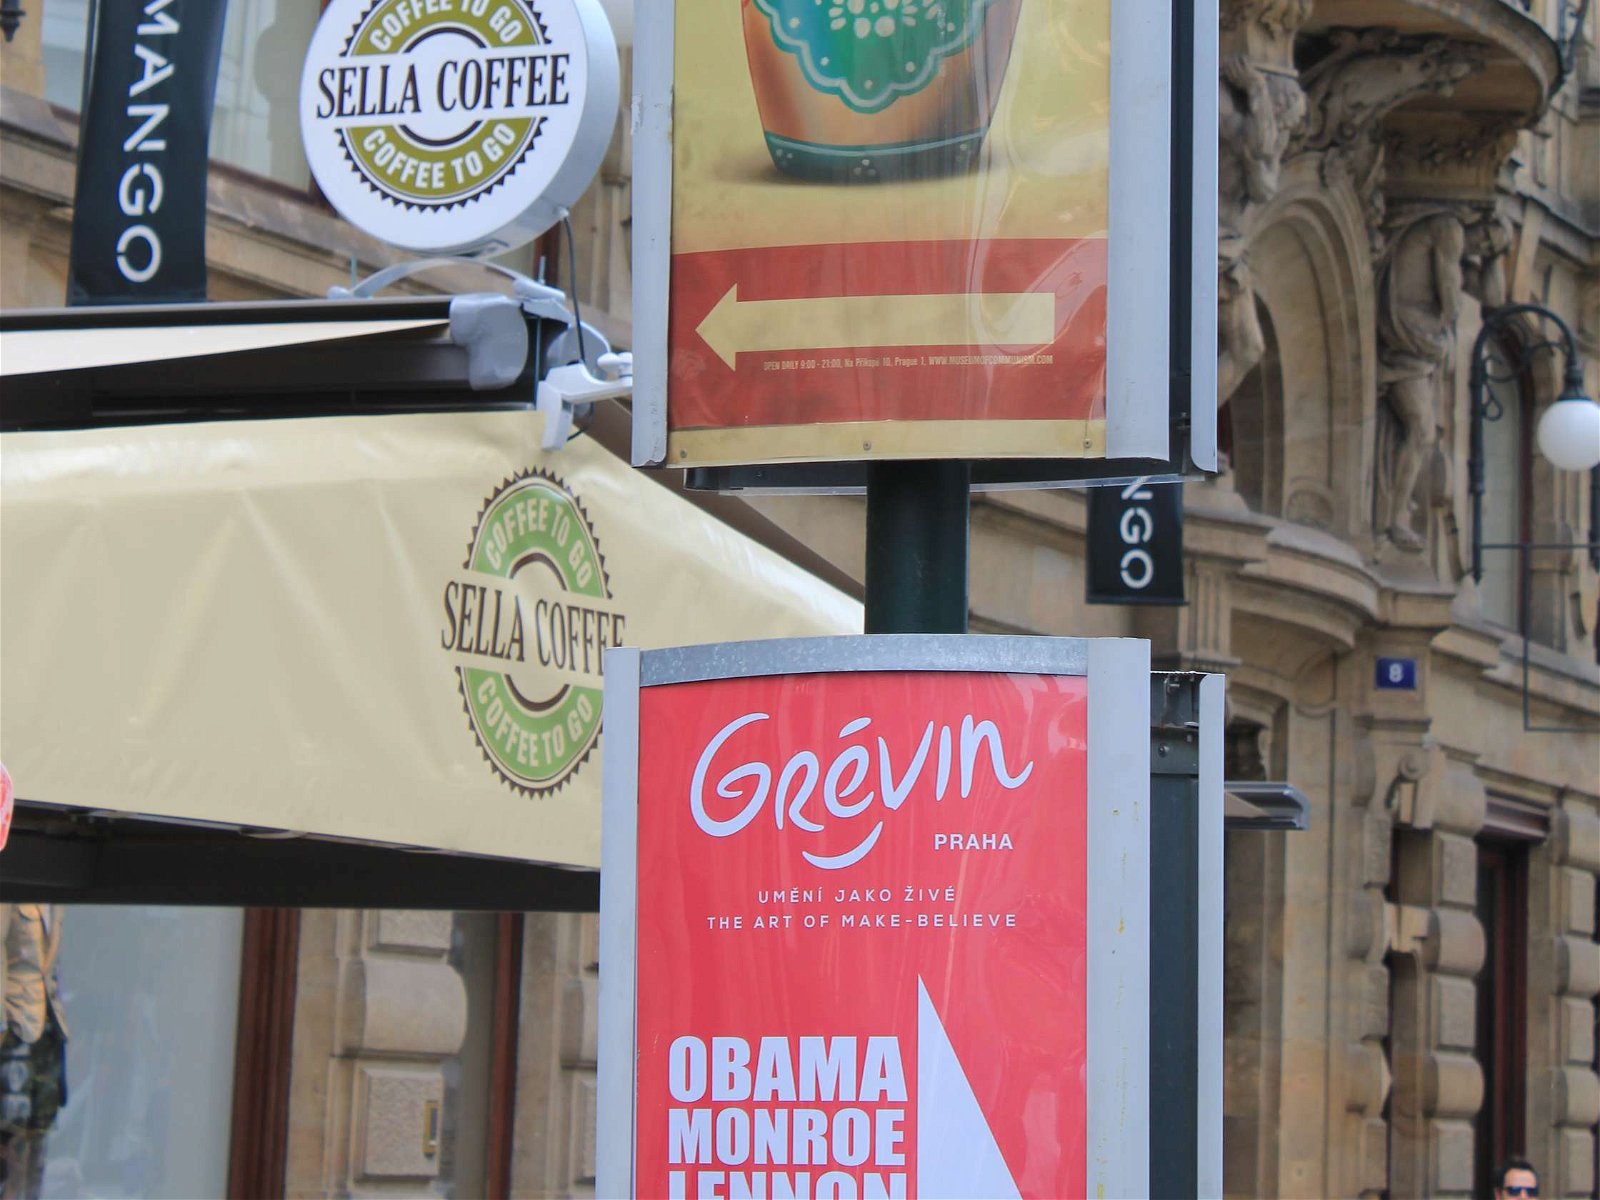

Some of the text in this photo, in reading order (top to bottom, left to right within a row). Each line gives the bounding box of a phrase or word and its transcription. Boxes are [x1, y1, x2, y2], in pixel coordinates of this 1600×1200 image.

[489, 5, 523, 43] GO
[316, 54, 570, 119] SELLA COFFEE
[363, 123, 516, 189] COFFEE TO GO
[894, 356, 918, 368] Prague
[485, 498, 592, 588] COFFEE TO GO
[1121, 476, 1154, 590] NGO
[441, 580, 525, 663] SELLA
[477, 676, 593, 767] COFFEE TO GO
[934, 833, 1013, 850] PRAHA
[707, 913, 1017, 929] THE ART OF MAKE-BELIEVE
[758, 885, 956, 904] UMĚNÍ JAKO ŽIVÉ
[668, 1035, 908, 1102] OBAMA
[668, 1107, 906, 1166] MONROE
